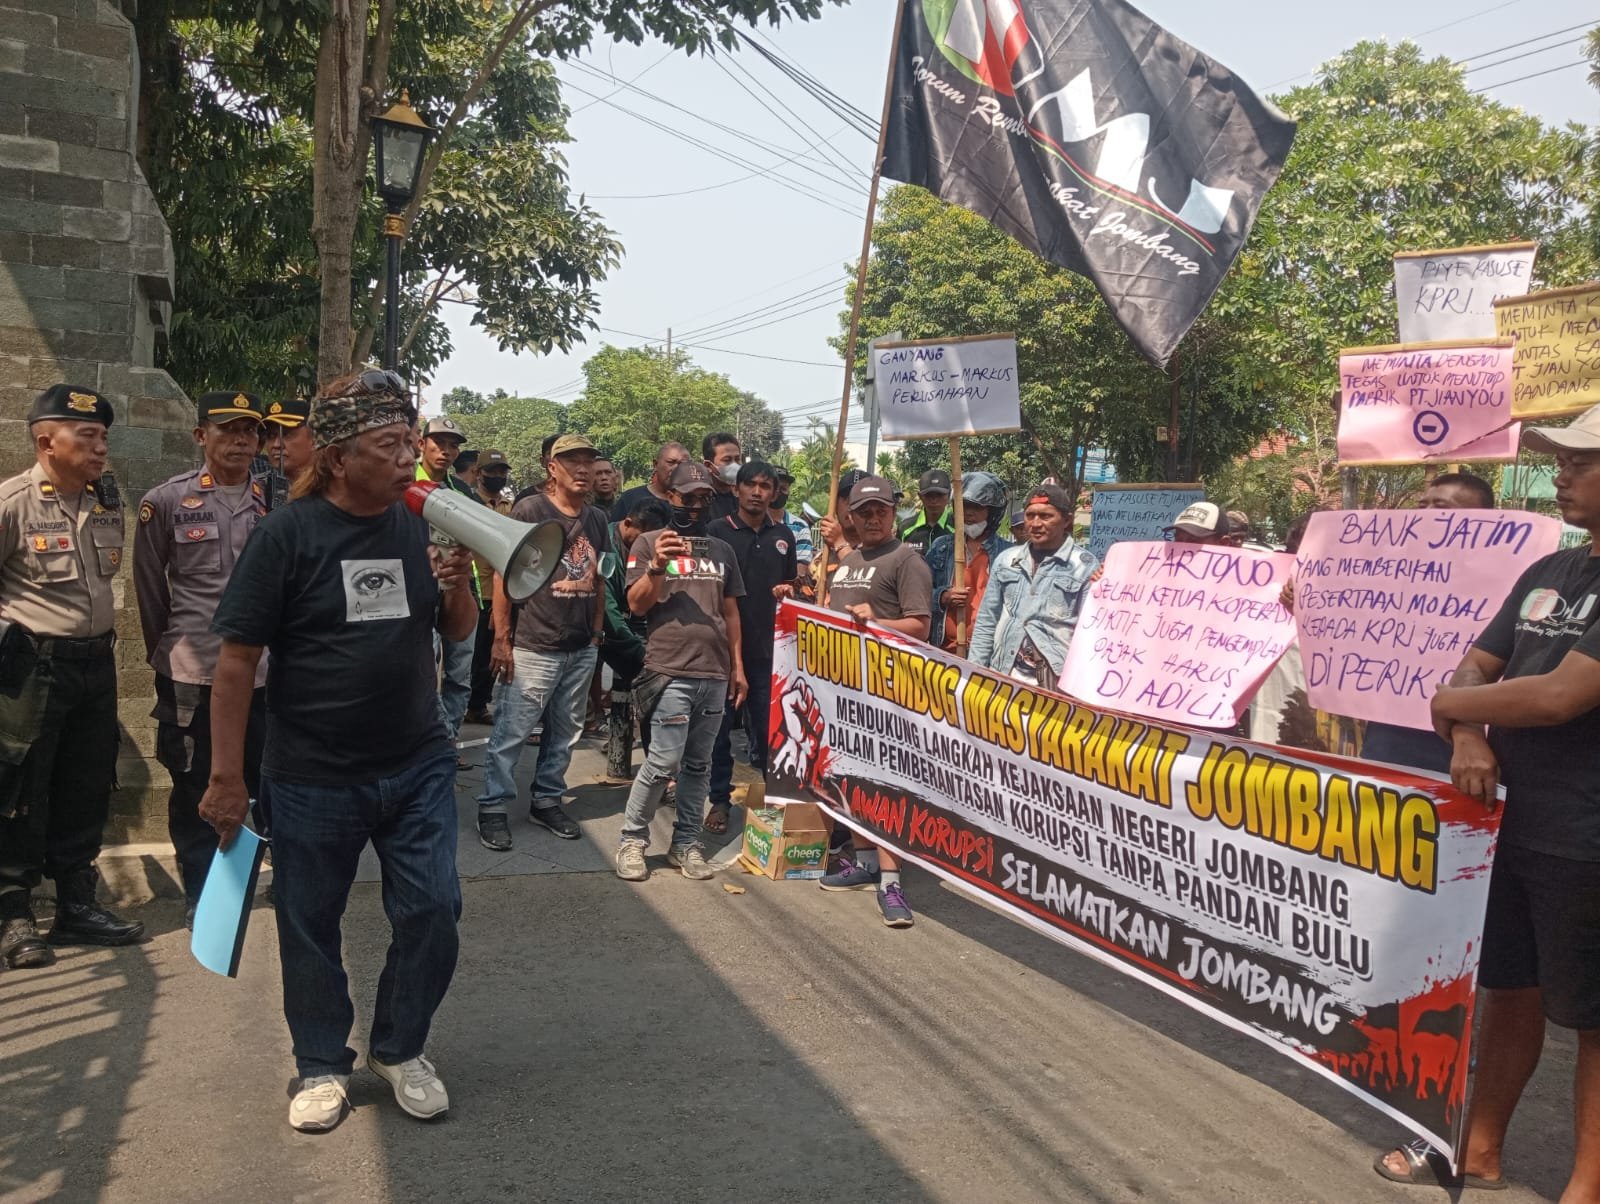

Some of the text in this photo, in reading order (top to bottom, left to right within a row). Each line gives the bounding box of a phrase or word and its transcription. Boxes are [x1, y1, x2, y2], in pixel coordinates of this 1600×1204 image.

[912, 56, 966, 105] Forum
[1091, 212, 1200, 276] Jombang
[1421, 261, 1528, 281] PIYE KASUSE
[1500, 300, 1577, 327] MEMINTA
[880, 348, 944, 365] GANYANG
[1361, 353, 1432, 373] MEMINTA
[892, 386, 989, 404] PERUSAHAAN
[92, 517, 121, 526] POLRI
[1339, 512, 1424, 548] BANK
[1138, 546, 1274, 587] HARTONO
[1295, 555, 1452, 584] YANG MEMBERIKAN
[1093, 578, 1145, 603] SELAKU
[1146, 586, 1206, 612] KETUA
[1299, 583, 1491, 622] PESERTAAN MODAL
[1161, 652, 1239, 689] HARUS
[796, 616, 1441, 895] FORUM REMBUG MASYARAKAT JOMBANG
[836, 695, 1349, 921] MENDUKUNG LANGKAH KEJAKSAAN NEGERI JOMBANG
[746, 825, 769, 857] cheers
[787, 846, 822, 859] cheers
[828, 723, 1370, 976] DALAM PEMBERANTASAN KORUPSI TANPA PANDAN BULU
[908, 803, 994, 877] KORUPSI
[1001, 852, 1170, 960] SELAMATKAN
[1178, 936, 1341, 1035] JOMBANG
